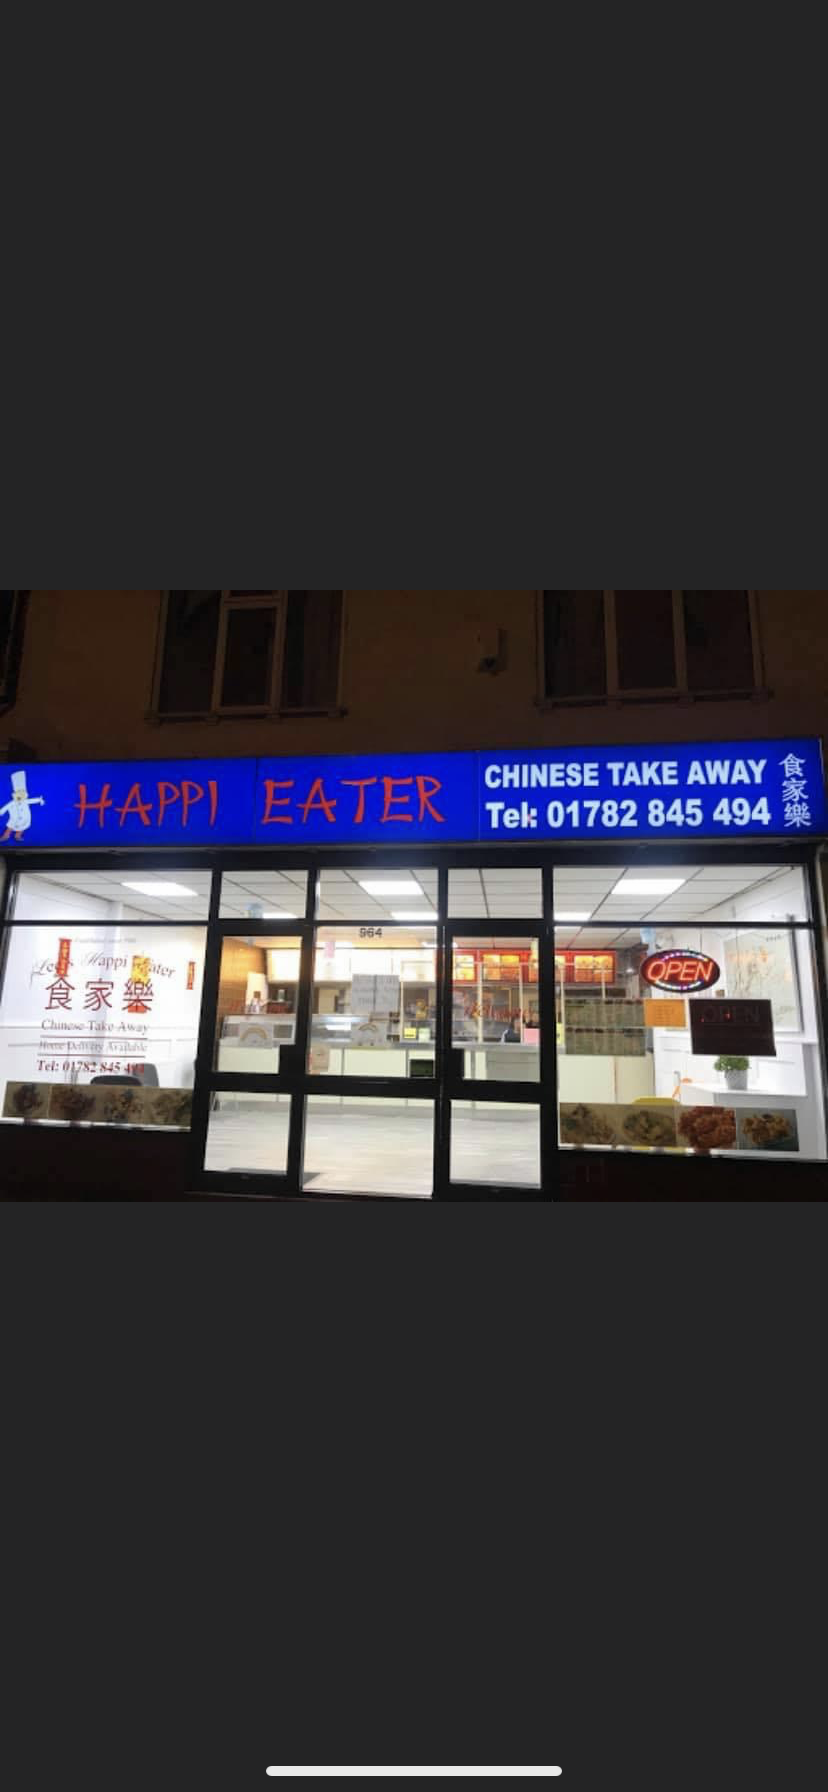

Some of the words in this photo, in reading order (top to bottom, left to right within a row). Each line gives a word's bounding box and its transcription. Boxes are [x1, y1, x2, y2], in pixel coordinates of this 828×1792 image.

[484, 763, 599, 789] CHINESE
[607, 761, 678, 786] TAKE
[686, 759, 767, 785] AWAY
[74, 780, 218, 829] HAPPI
[261, 775, 447, 824] EATER
[486, 800, 537, 829] Tel:
[547, 799, 638, 828] 01782
[647, 798, 703, 827] 845
[713, 797, 771, 825] 494
[359, 927, 382, 938] 964
[647, 960, 713, 983] OPEN
[41, 1018, 84, 1031] Chinese
[88, 1020, 114, 1031] Take
